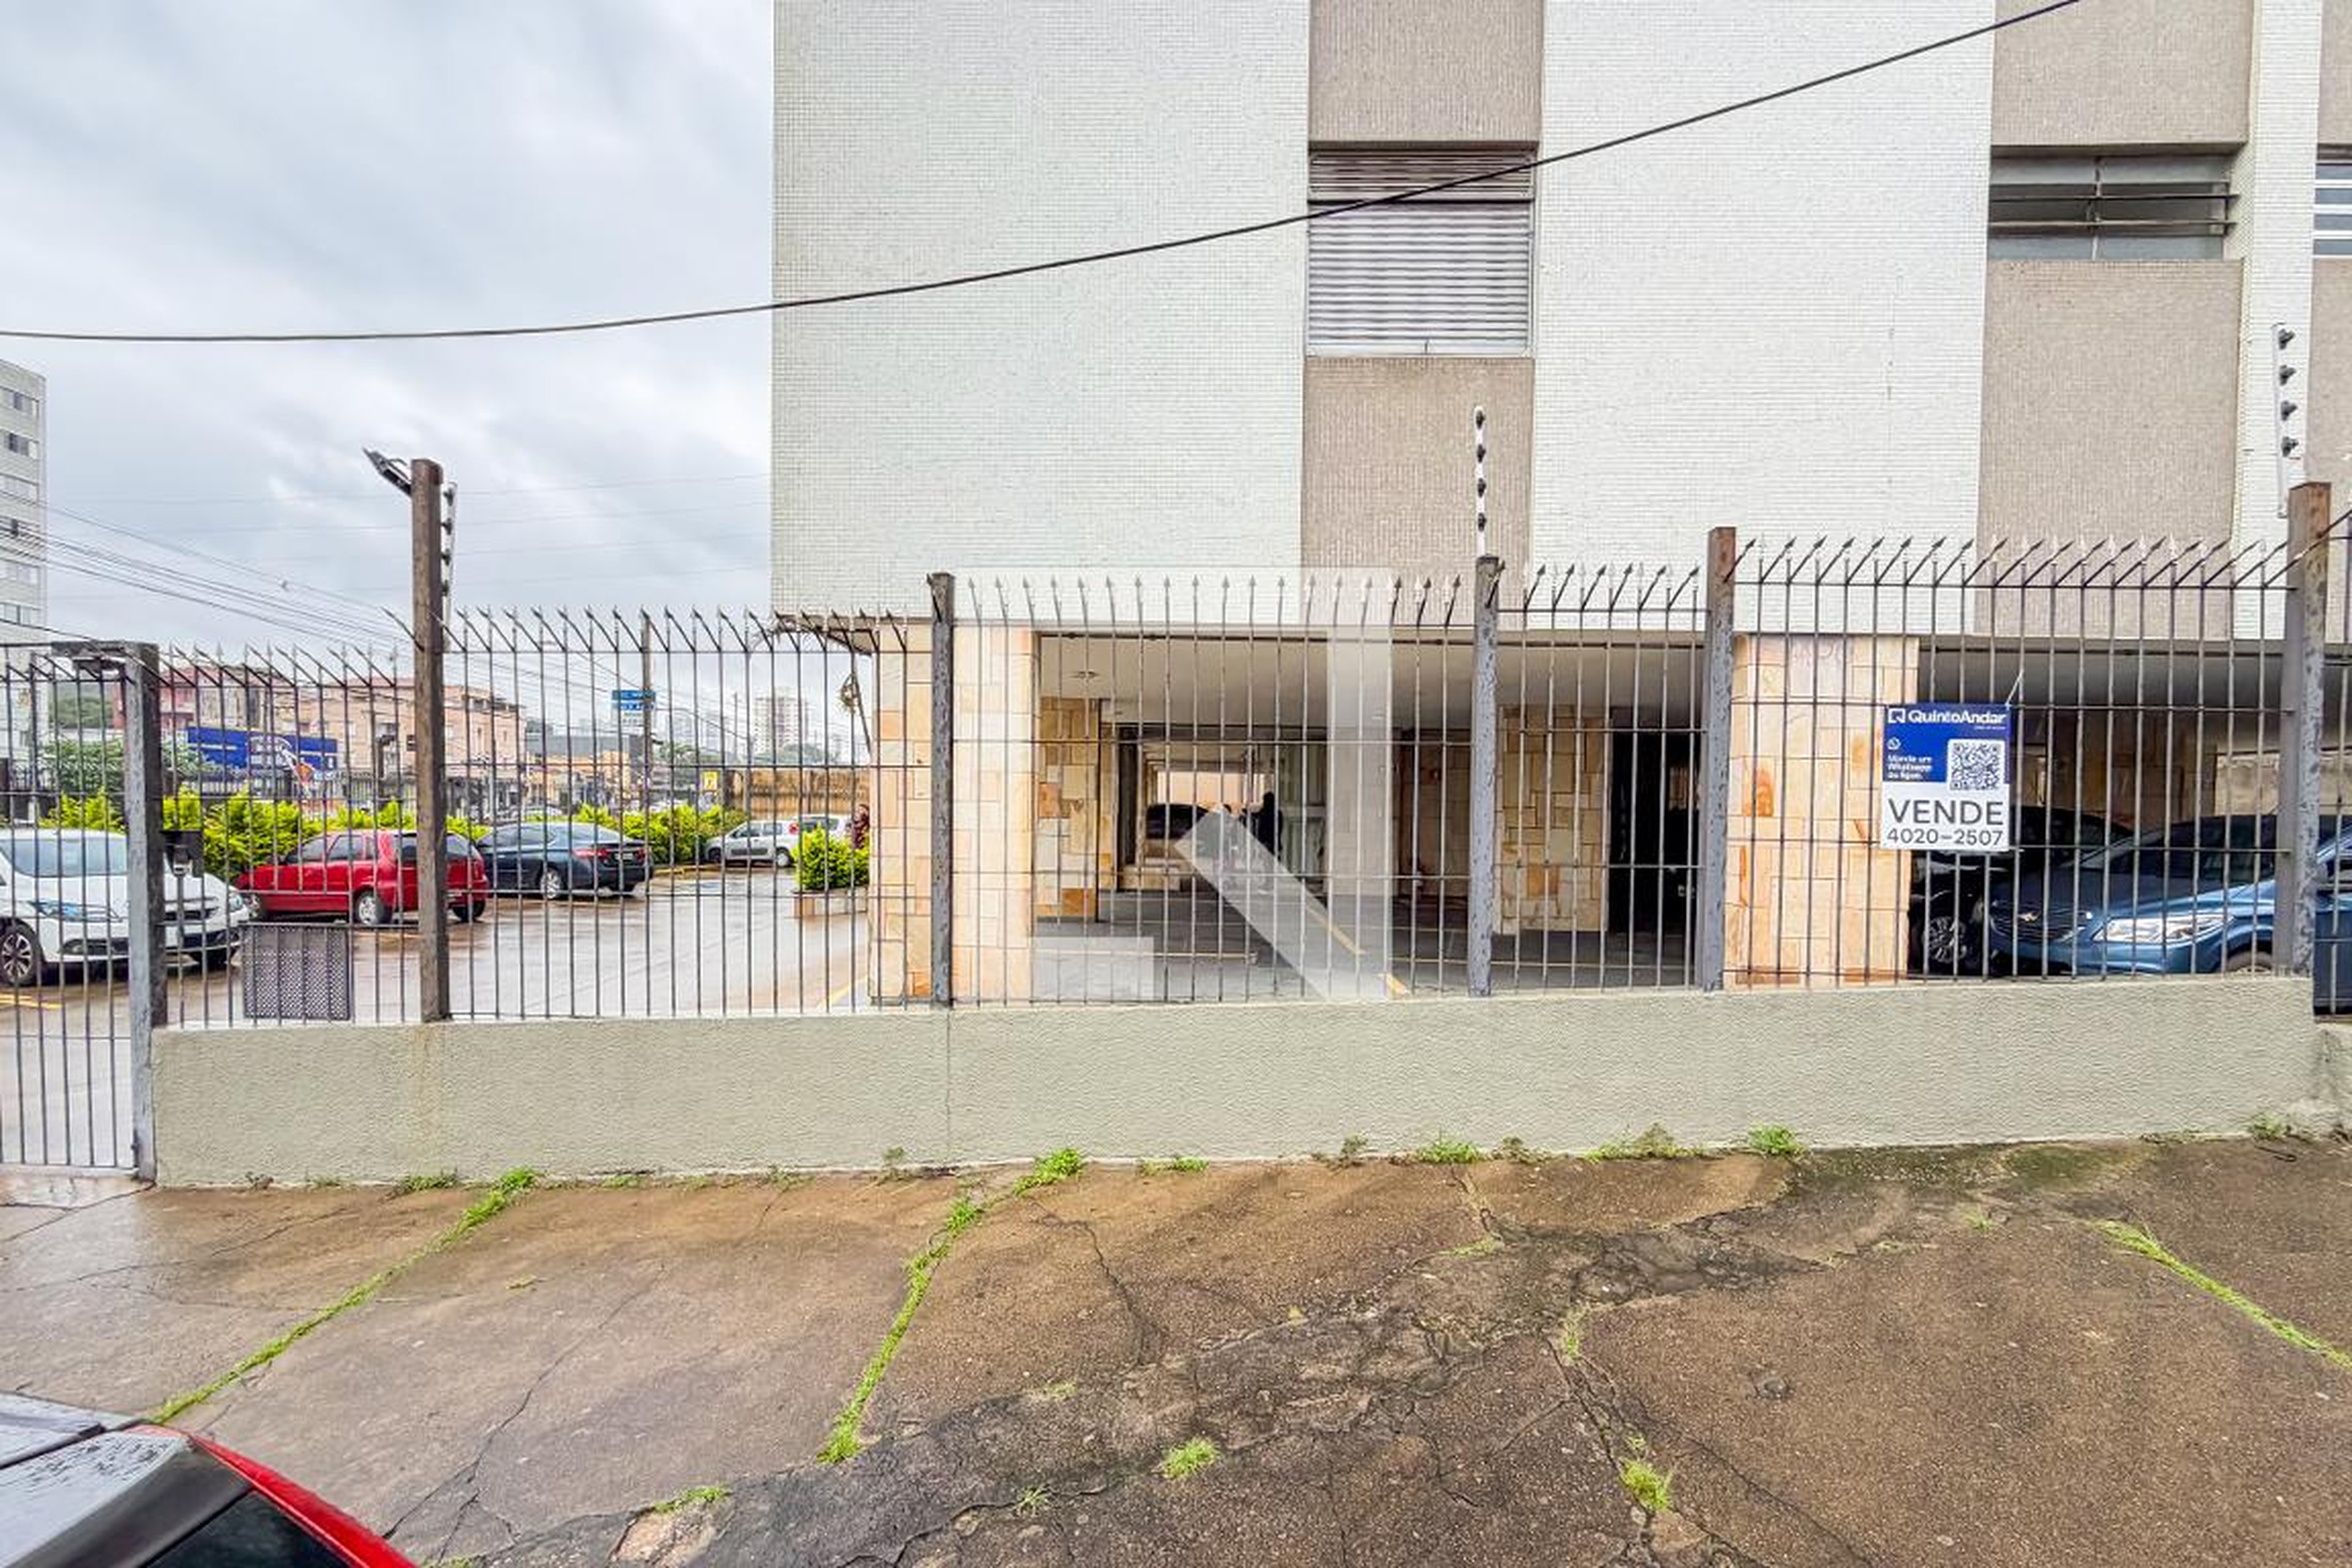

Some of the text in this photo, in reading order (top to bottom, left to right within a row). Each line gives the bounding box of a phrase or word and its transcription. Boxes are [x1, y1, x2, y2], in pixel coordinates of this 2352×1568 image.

[1908, 710, 2007, 723] QuintoAndar
[1888, 799, 2003, 825] VENDE
[1887, 828, 2003, 845] 4020-2507
